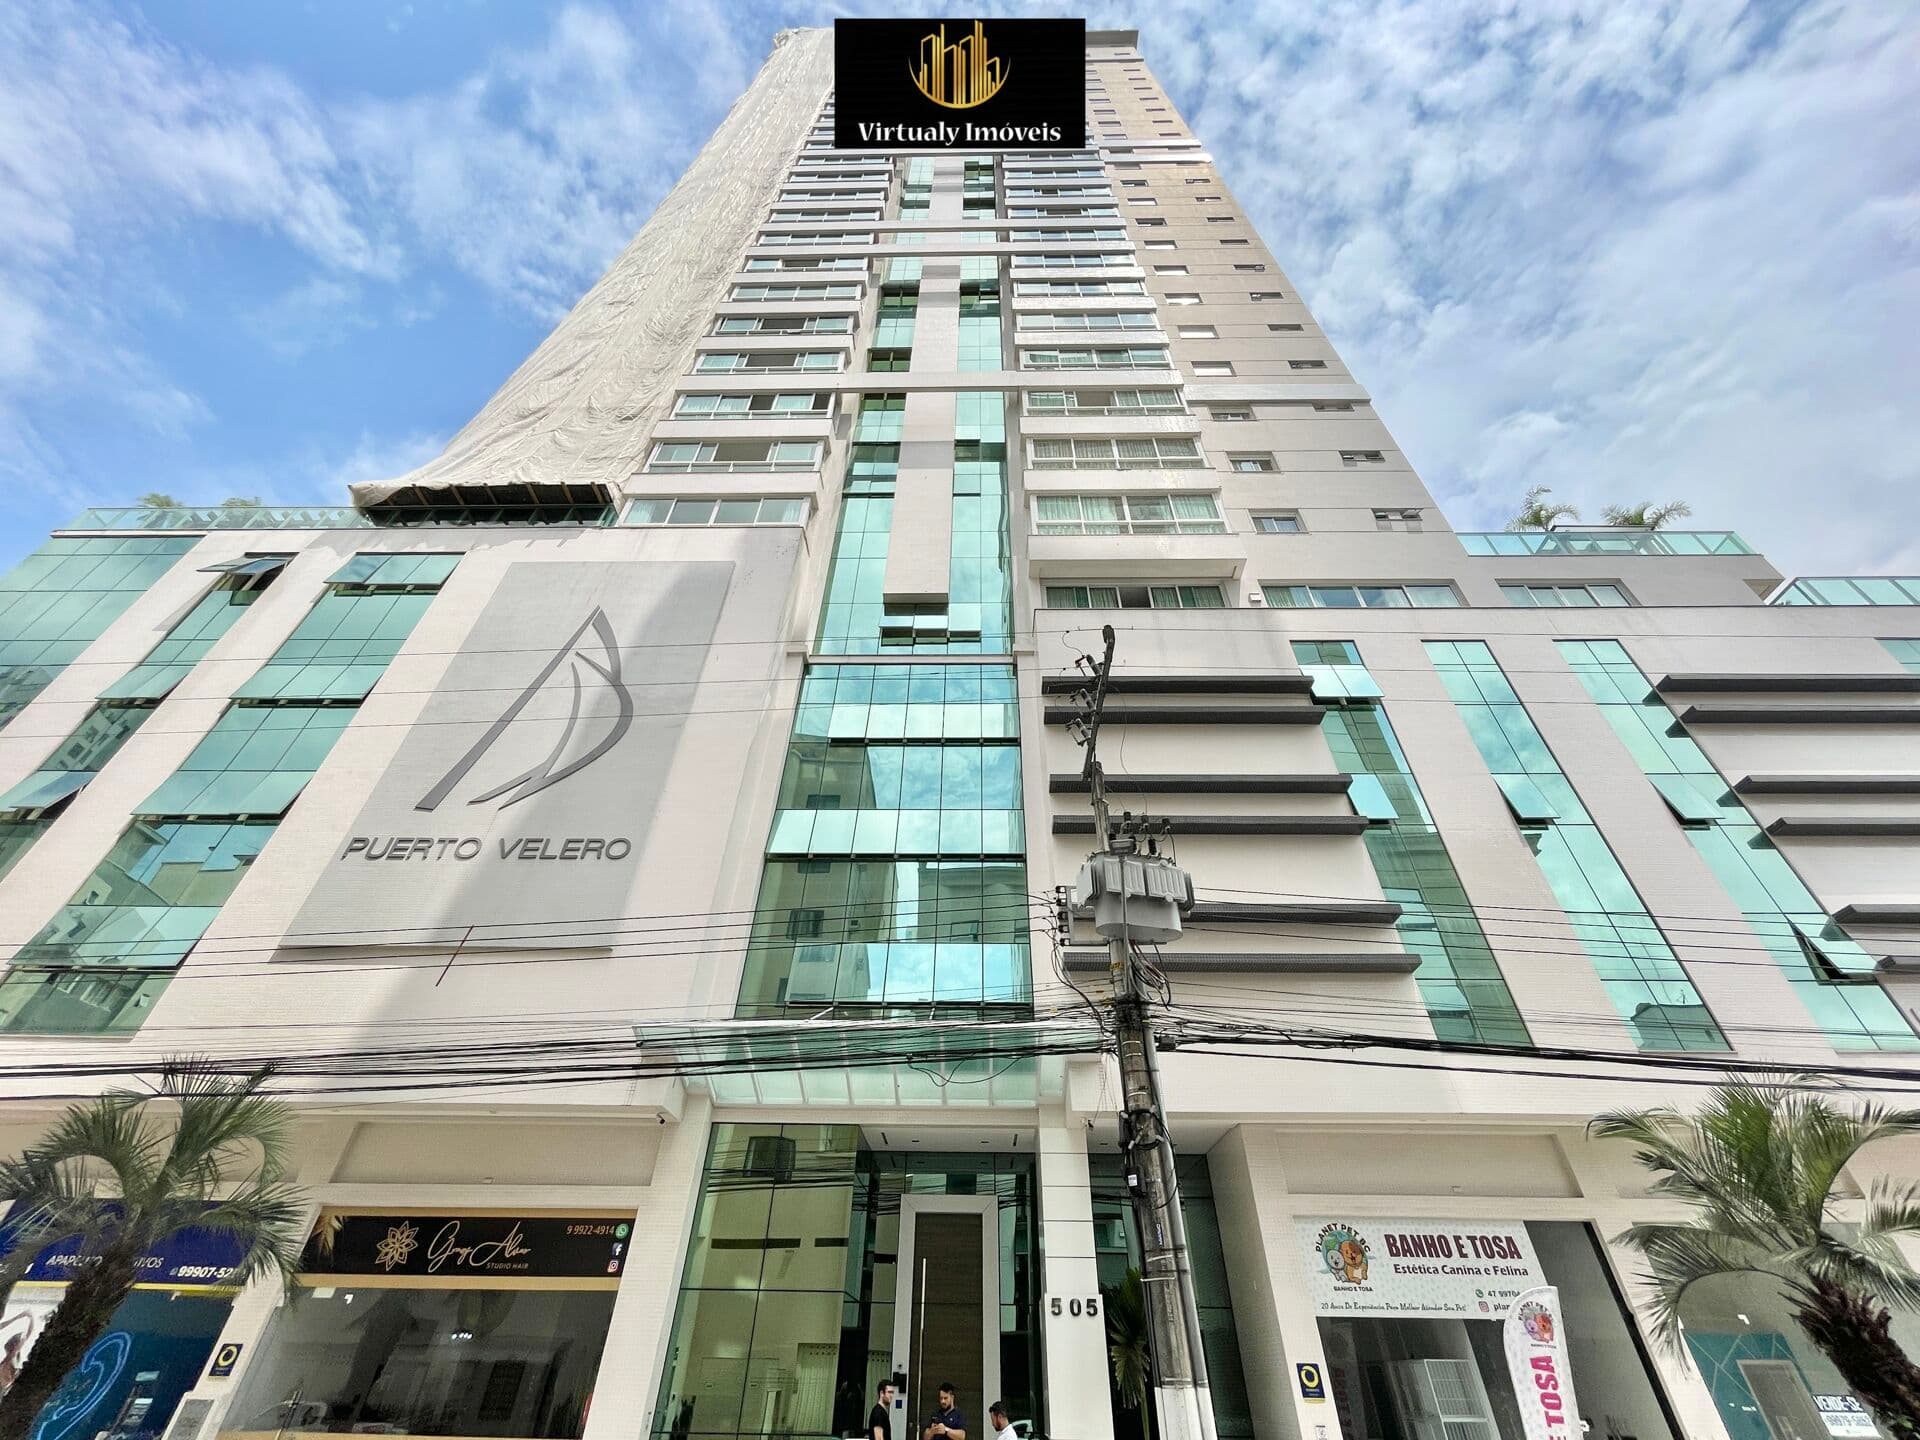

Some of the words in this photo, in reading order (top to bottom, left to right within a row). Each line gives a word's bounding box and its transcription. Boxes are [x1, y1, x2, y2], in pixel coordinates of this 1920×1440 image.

[340, 837, 483, 861] PUERTO
[499, 837, 632, 860] VELERO
[1315, 1223, 1338, 1253] PLANET
[1341, 1224, 1359, 1238] PET
[1384, 1234, 1453, 1259] BANHO
[1453, 1235, 1469, 1259] E
[1466, 1235, 1523, 1260] TOSA
[486, 1262, 511, 1270] STUDIO
[512, 1262, 529, 1270] HAIR
[1393, 1263, 1440, 1275] Estética
[1441, 1265, 1482, 1276] Canina
[1484, 1267, 1491, 1276] e
[1493, 1266, 1529, 1277] Felina
[1321, 1302, 1329, 1310] 20
[1530, 1356, 1565, 1428] TOSA
